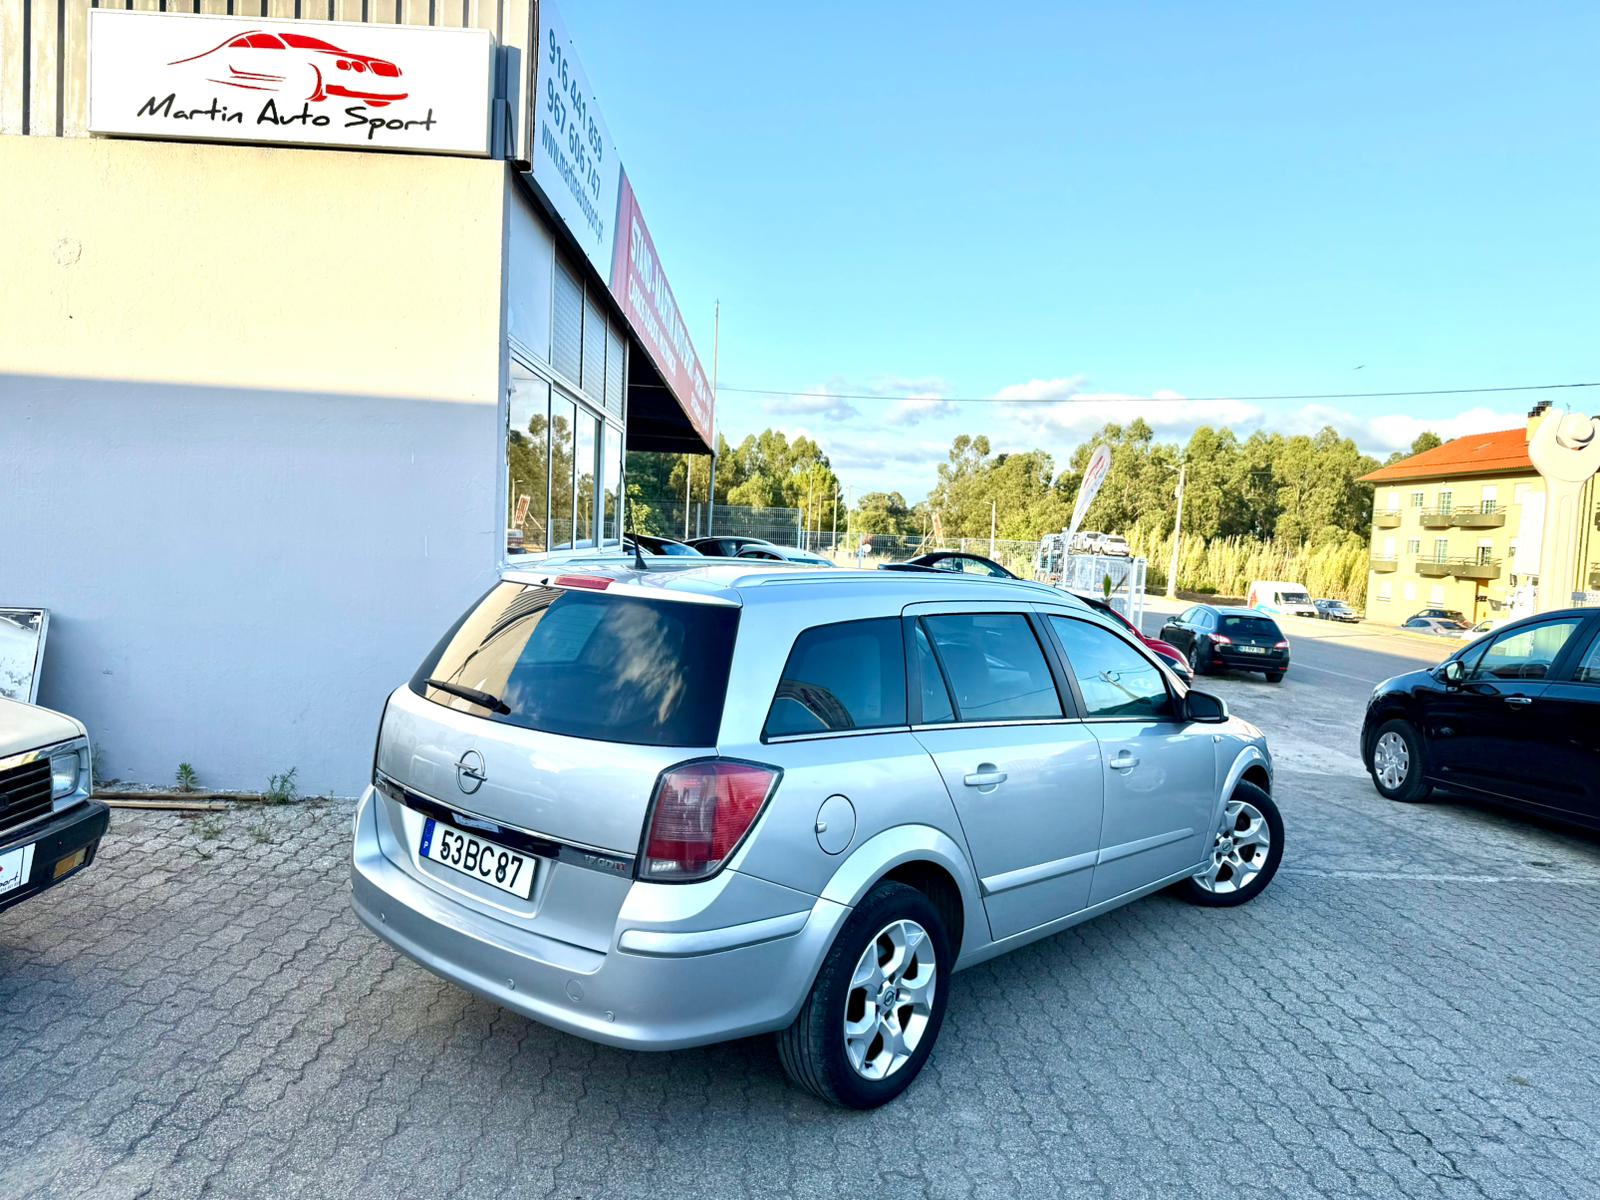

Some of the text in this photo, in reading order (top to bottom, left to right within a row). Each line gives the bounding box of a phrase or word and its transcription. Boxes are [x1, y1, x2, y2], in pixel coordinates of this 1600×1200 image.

[137, 93, 437, 140] Martin Auto Sport
[547, 77, 601, 201] 967 606 747
[549, 28, 603, 162] 916 441 859
